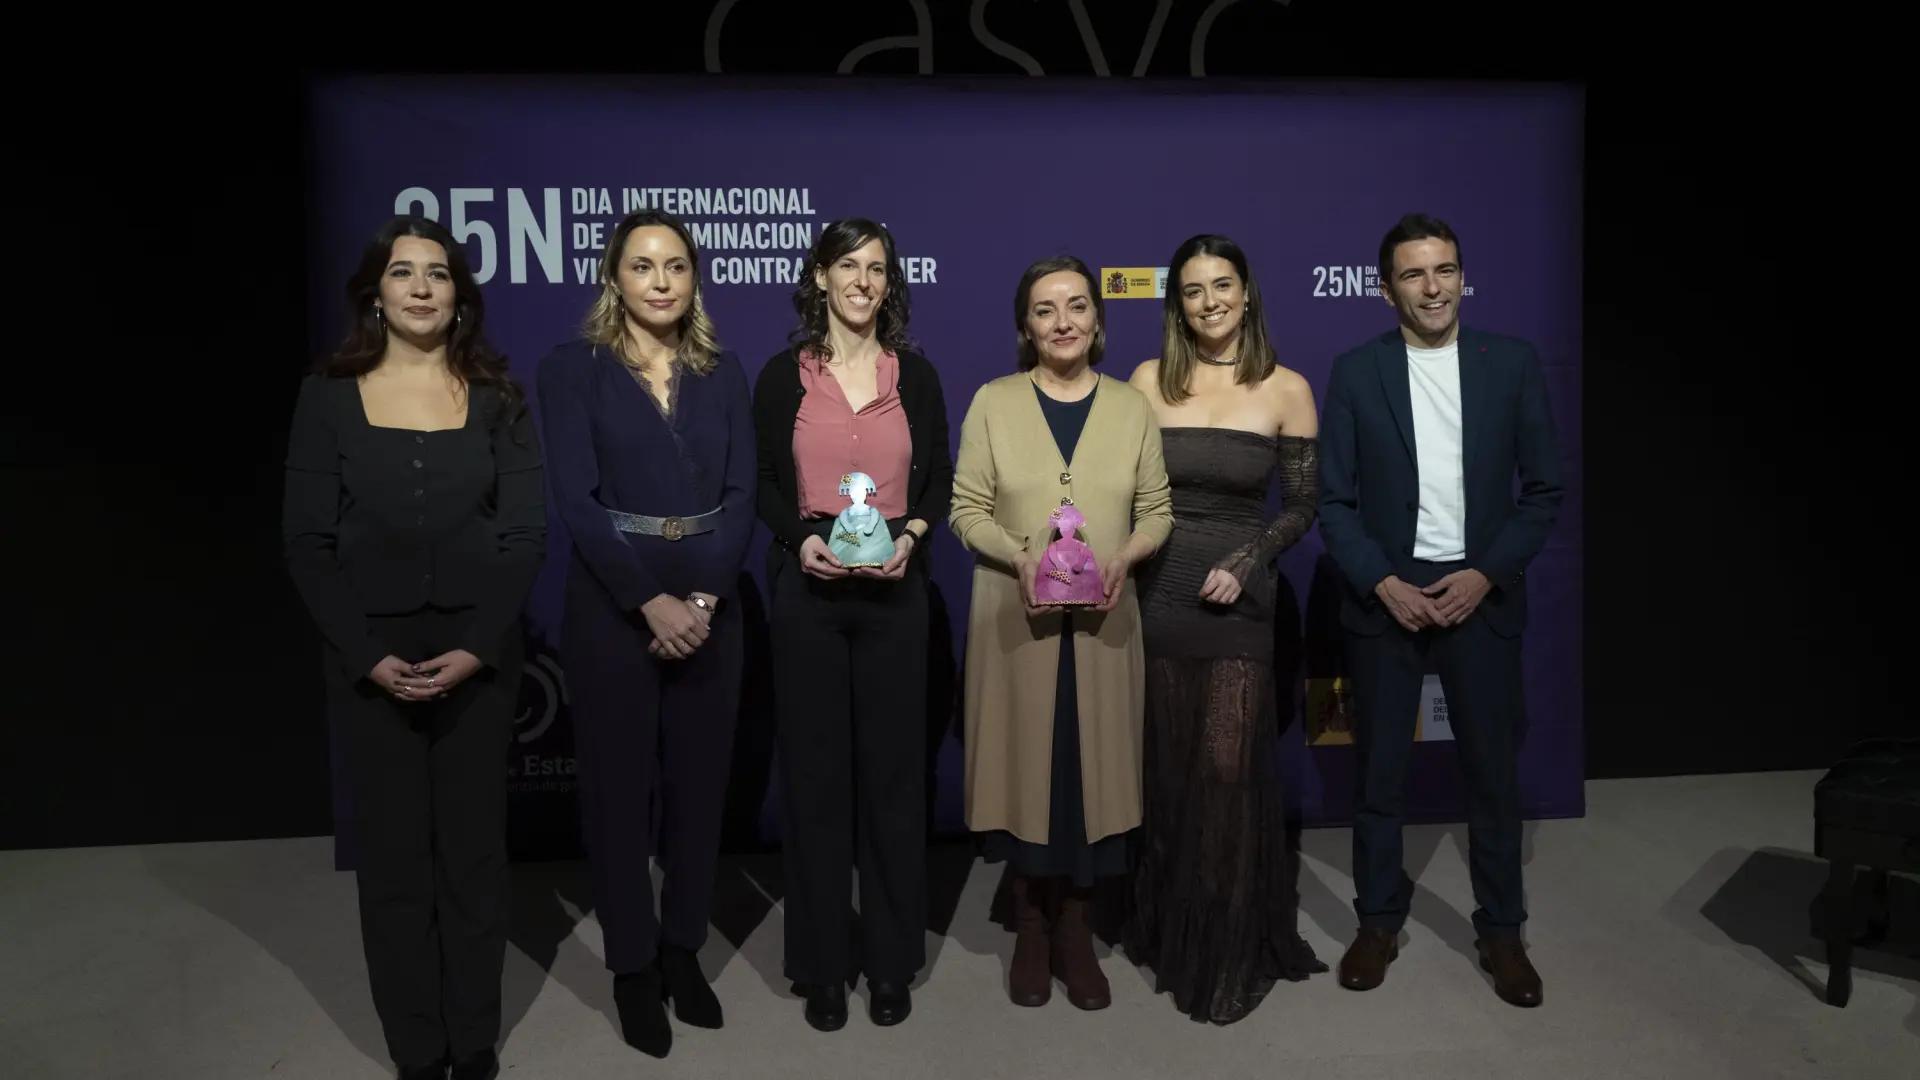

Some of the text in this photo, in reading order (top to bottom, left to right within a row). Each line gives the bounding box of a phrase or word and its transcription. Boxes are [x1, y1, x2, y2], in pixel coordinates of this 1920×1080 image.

[571, 187, 816, 215] DIA INTERNACIONAL
[572, 222, 605, 249] DE
[1313, 266, 1362, 297] 25N
[1365, 266, 1378, 275] DIA
[1365, 277, 1375, 286] DE
